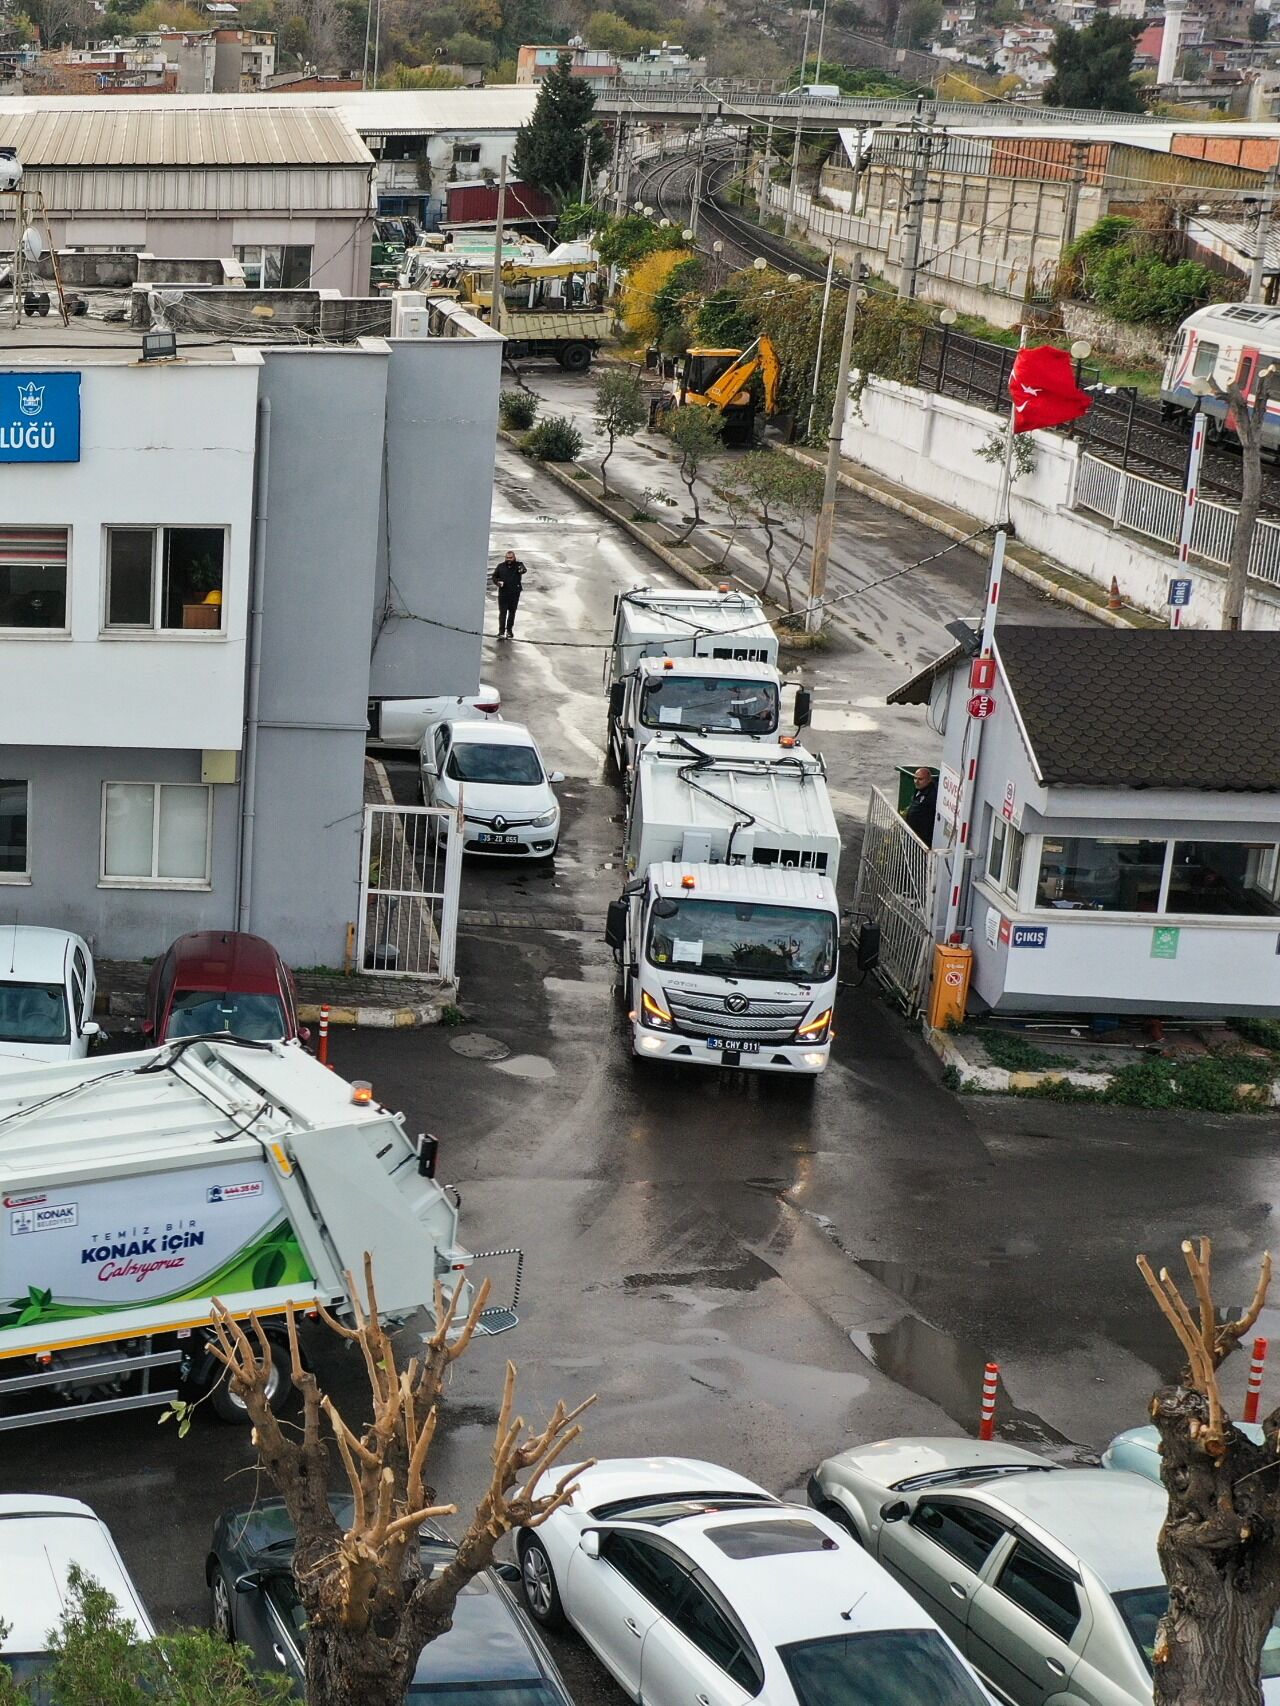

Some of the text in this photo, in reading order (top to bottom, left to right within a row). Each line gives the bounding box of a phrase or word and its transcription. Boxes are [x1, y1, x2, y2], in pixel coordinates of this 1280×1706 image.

[1173, 581, 1189, 604] GİRİŞ
[978, 696, 988, 717] DUR
[1015, 931, 1045, 945] ÇIKIŞ
[712, 1038, 758, 1051] 35 CHY 811
[250, 1183, 260, 1191] 66
[36, 1207, 74, 1221] KONAK
[91, 1219, 196, 1242] TEMİZ BİR
[81, 1238, 157, 1264] KONAK
